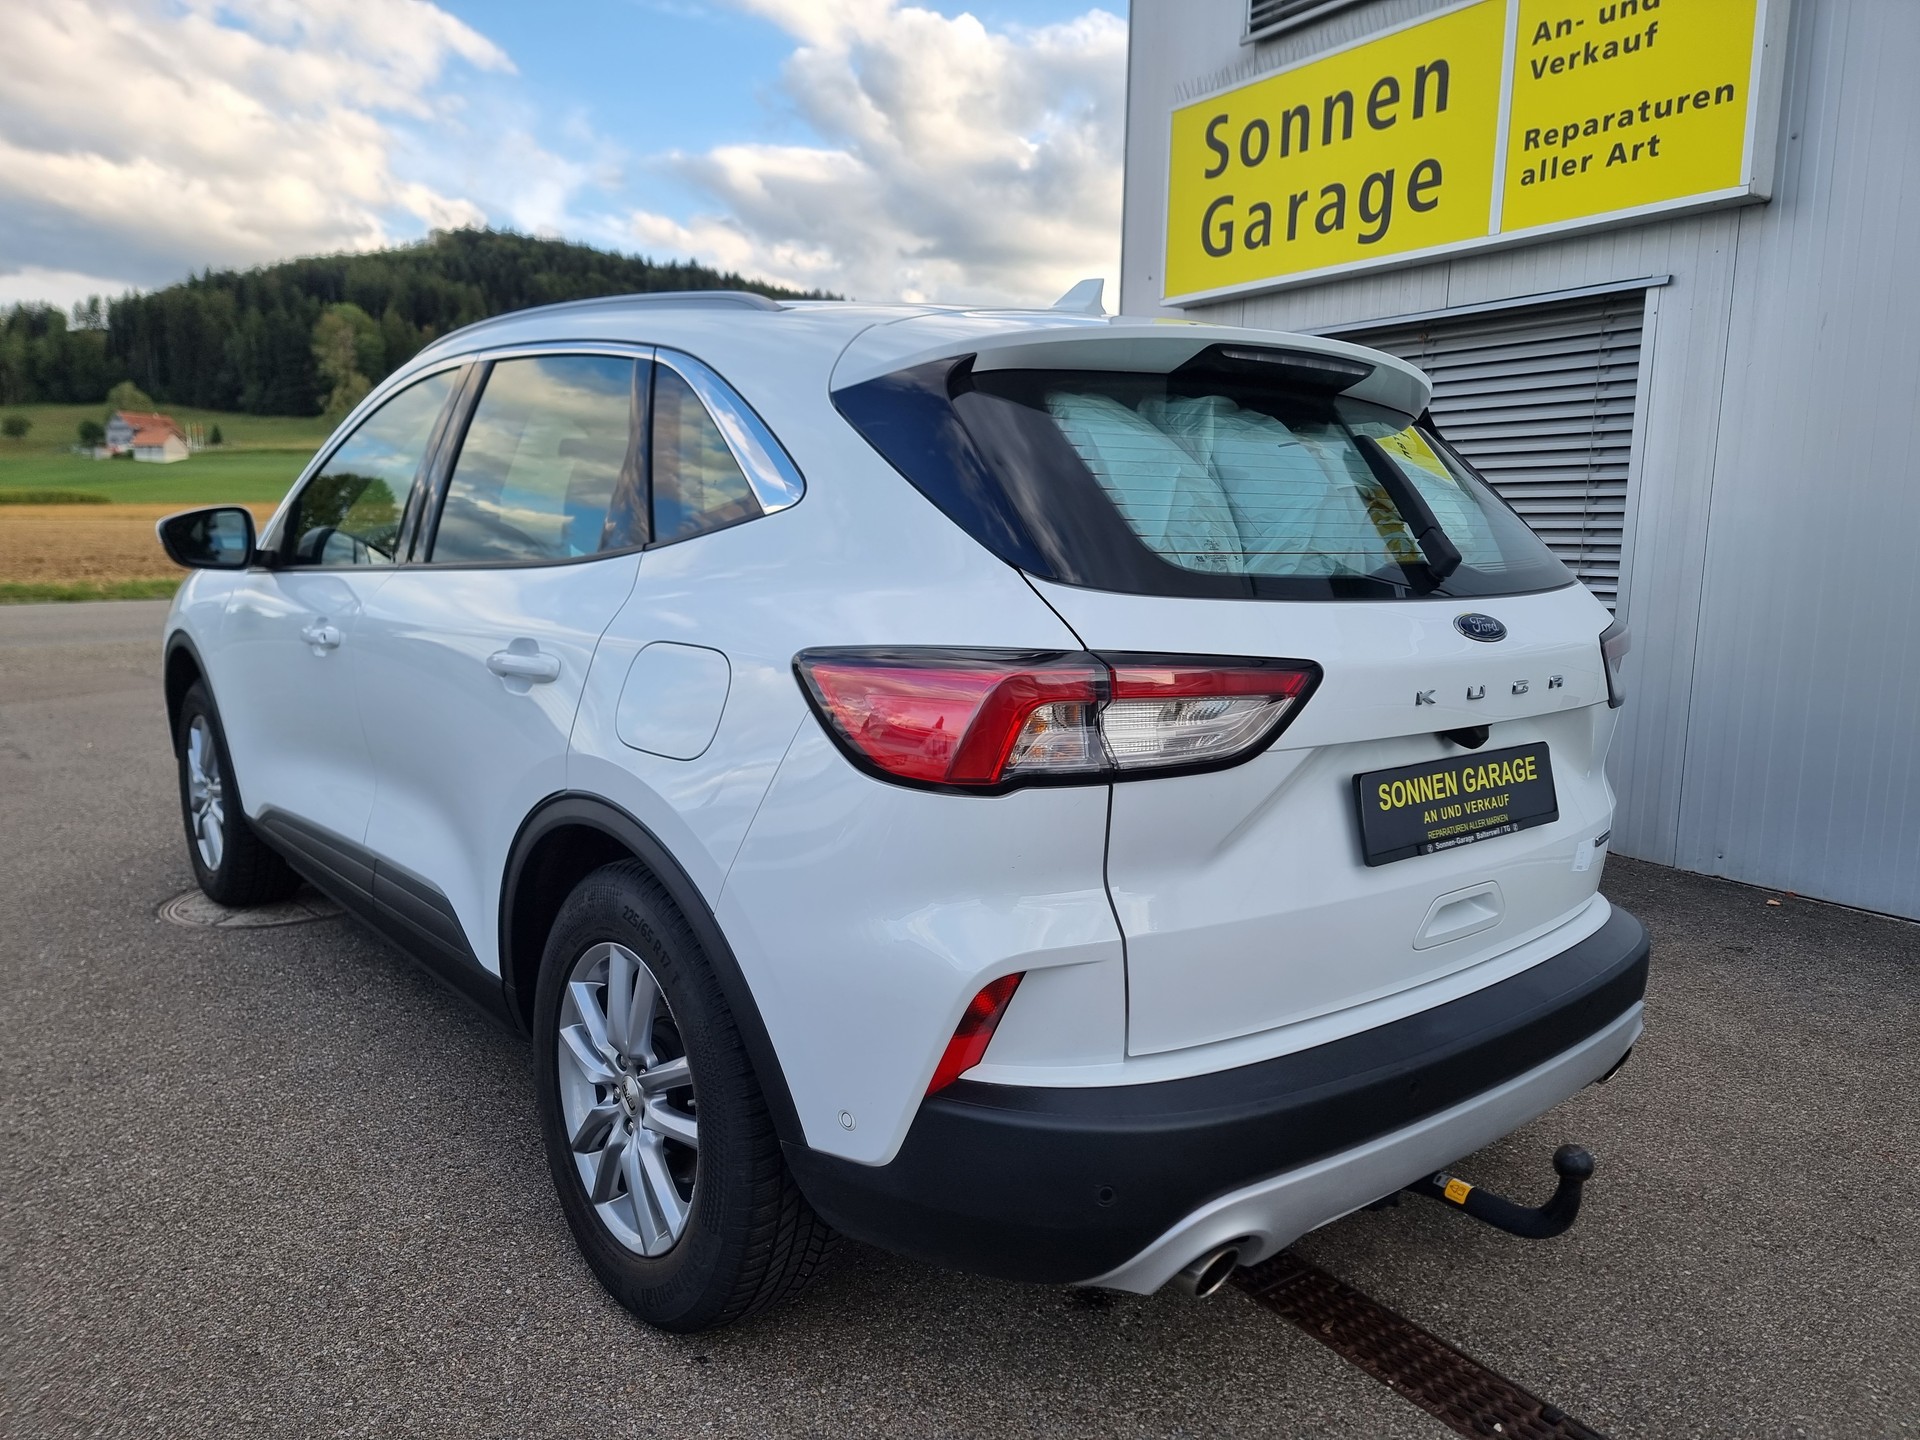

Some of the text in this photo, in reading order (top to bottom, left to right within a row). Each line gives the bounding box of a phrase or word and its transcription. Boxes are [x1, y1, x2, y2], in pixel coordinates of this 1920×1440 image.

[1530, 21, 1659, 80] Verkauf
[1532, 18, 1584, 46] An-
[1204, 59, 1450, 180] Sonnen
[1524, 83, 1735, 151] Reparaturen
[1520, 135, 1661, 186] aller Art
[1201, 158, 1443, 258] Garage
[1470, 616, 1500, 632] Ford
[1378, 756, 1538, 811] SONNEN GARAGE
[1424, 794, 1510, 824] AN UND VERKAUF
[1428, 814, 1508, 839] REPARATUREN ALLER MARKEN
[1435, 836, 1474, 849] Sonnen-Garage
[622, 905, 654, 944] 225/65
